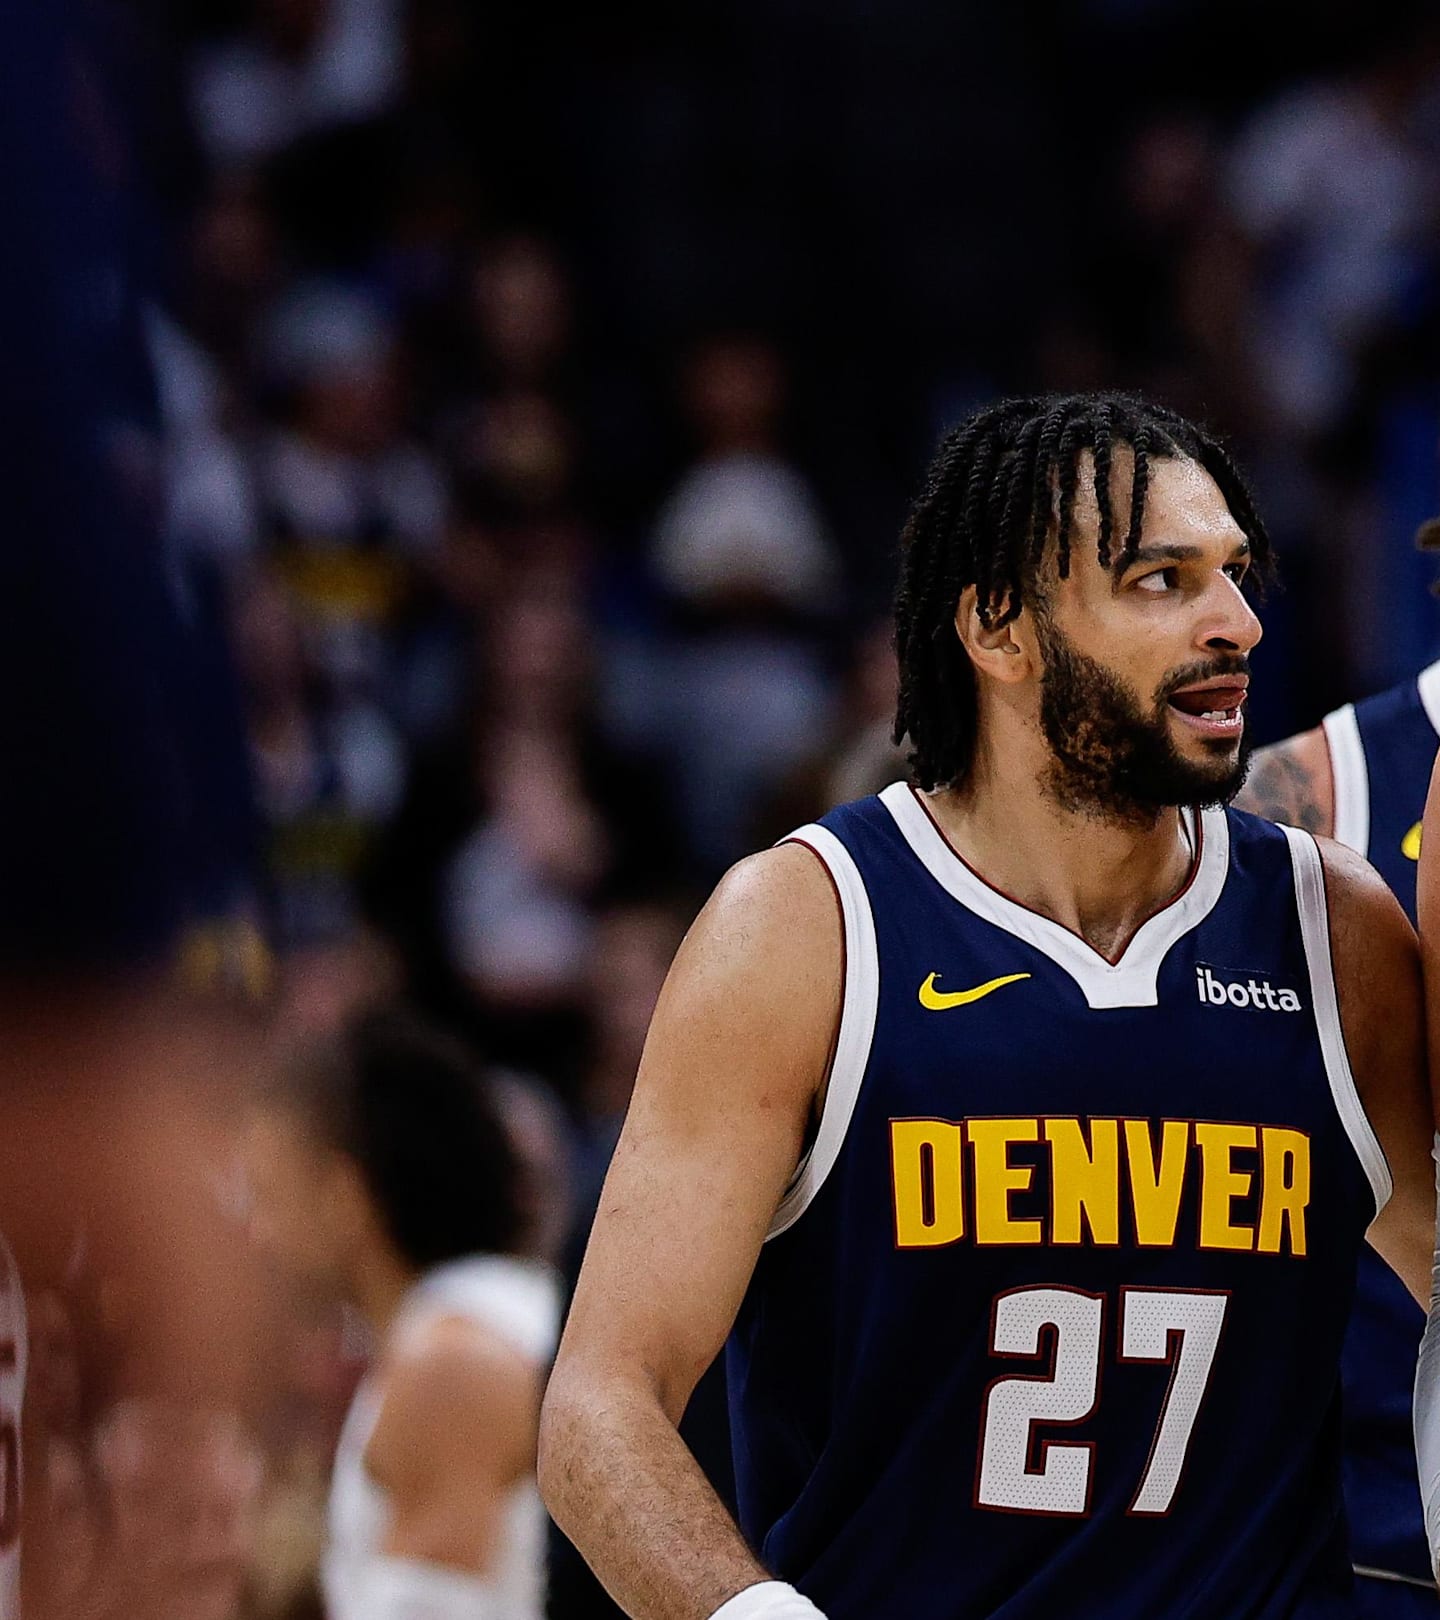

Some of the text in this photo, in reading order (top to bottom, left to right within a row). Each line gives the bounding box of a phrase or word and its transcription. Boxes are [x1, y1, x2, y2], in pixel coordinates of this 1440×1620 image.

[1195, 965, 1303, 1012] ibotta
[888, 1115, 1312, 1260] DENVER
[972, 1282, 1233, 1518] 27
